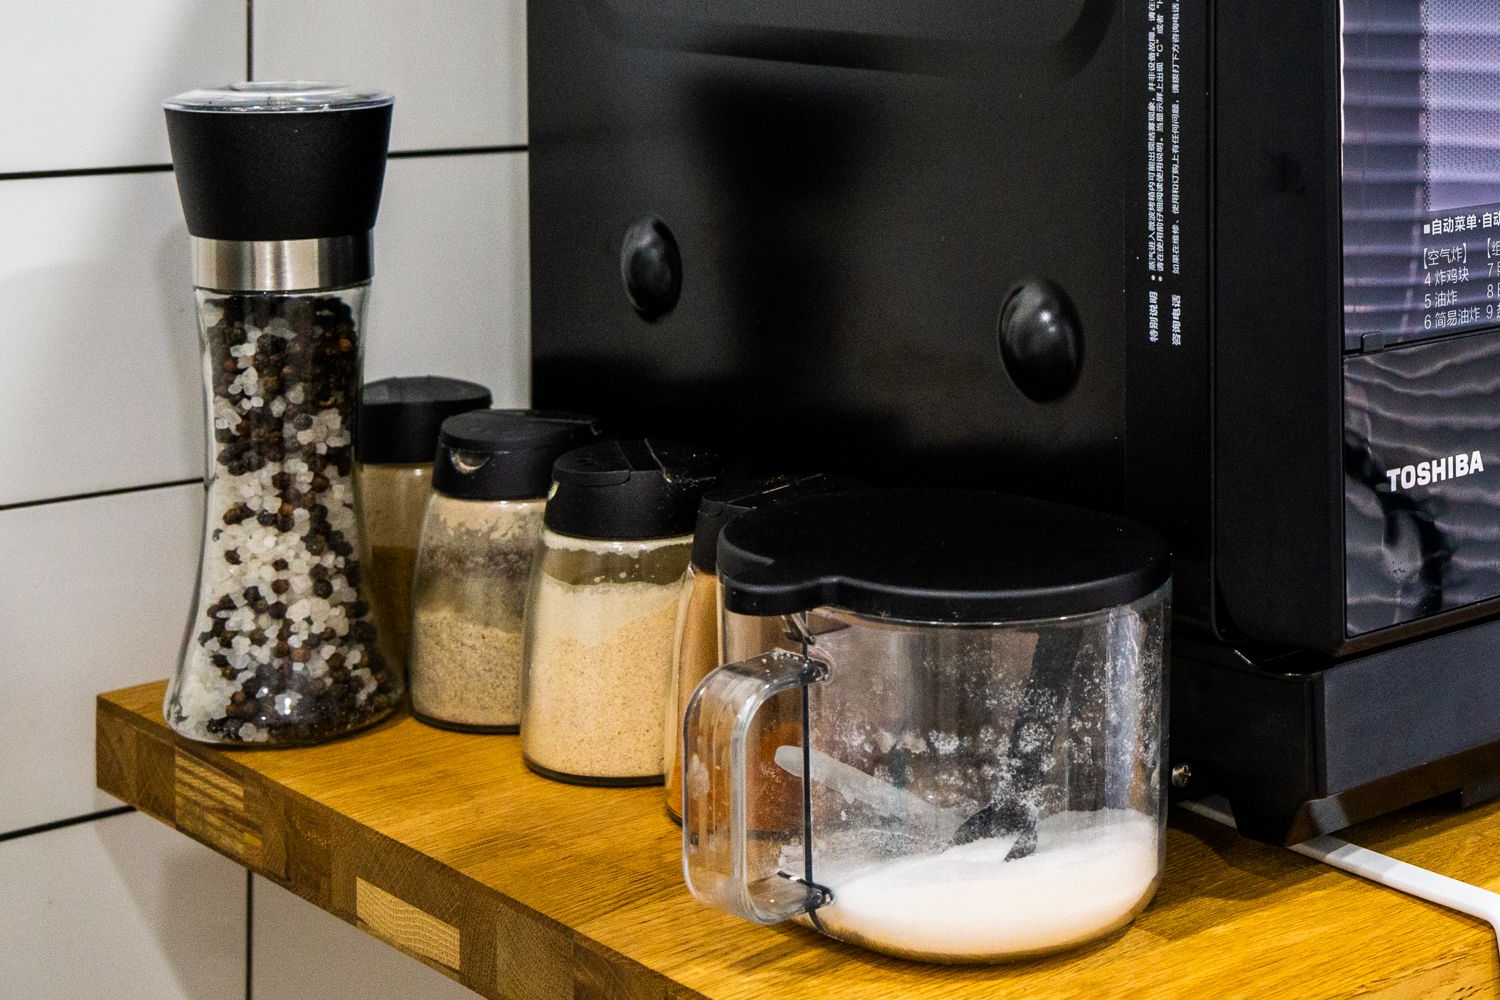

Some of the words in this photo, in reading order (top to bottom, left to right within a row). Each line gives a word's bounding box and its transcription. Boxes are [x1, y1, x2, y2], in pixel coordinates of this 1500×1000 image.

[1424, 272, 1431, 286] 4
[1434, 266, 1469, 286] 炸鸡块
[1488, 264, 1493, 276] 7
[1425, 294, 1431, 308] 5
[1435, 290, 1458, 307] 油炸
[1487, 284, 1493, 298] 8
[1149, 291, 1159, 342] 特别说明
[1172, 294, 1181, 346] 咨询电话
[1425, 316, 1431, 329] 6
[1435, 307, 1480, 328] 简易油炸
[1486, 305, 1493, 318] 9
[1386, 451, 1484, 492] TOSHIBA
